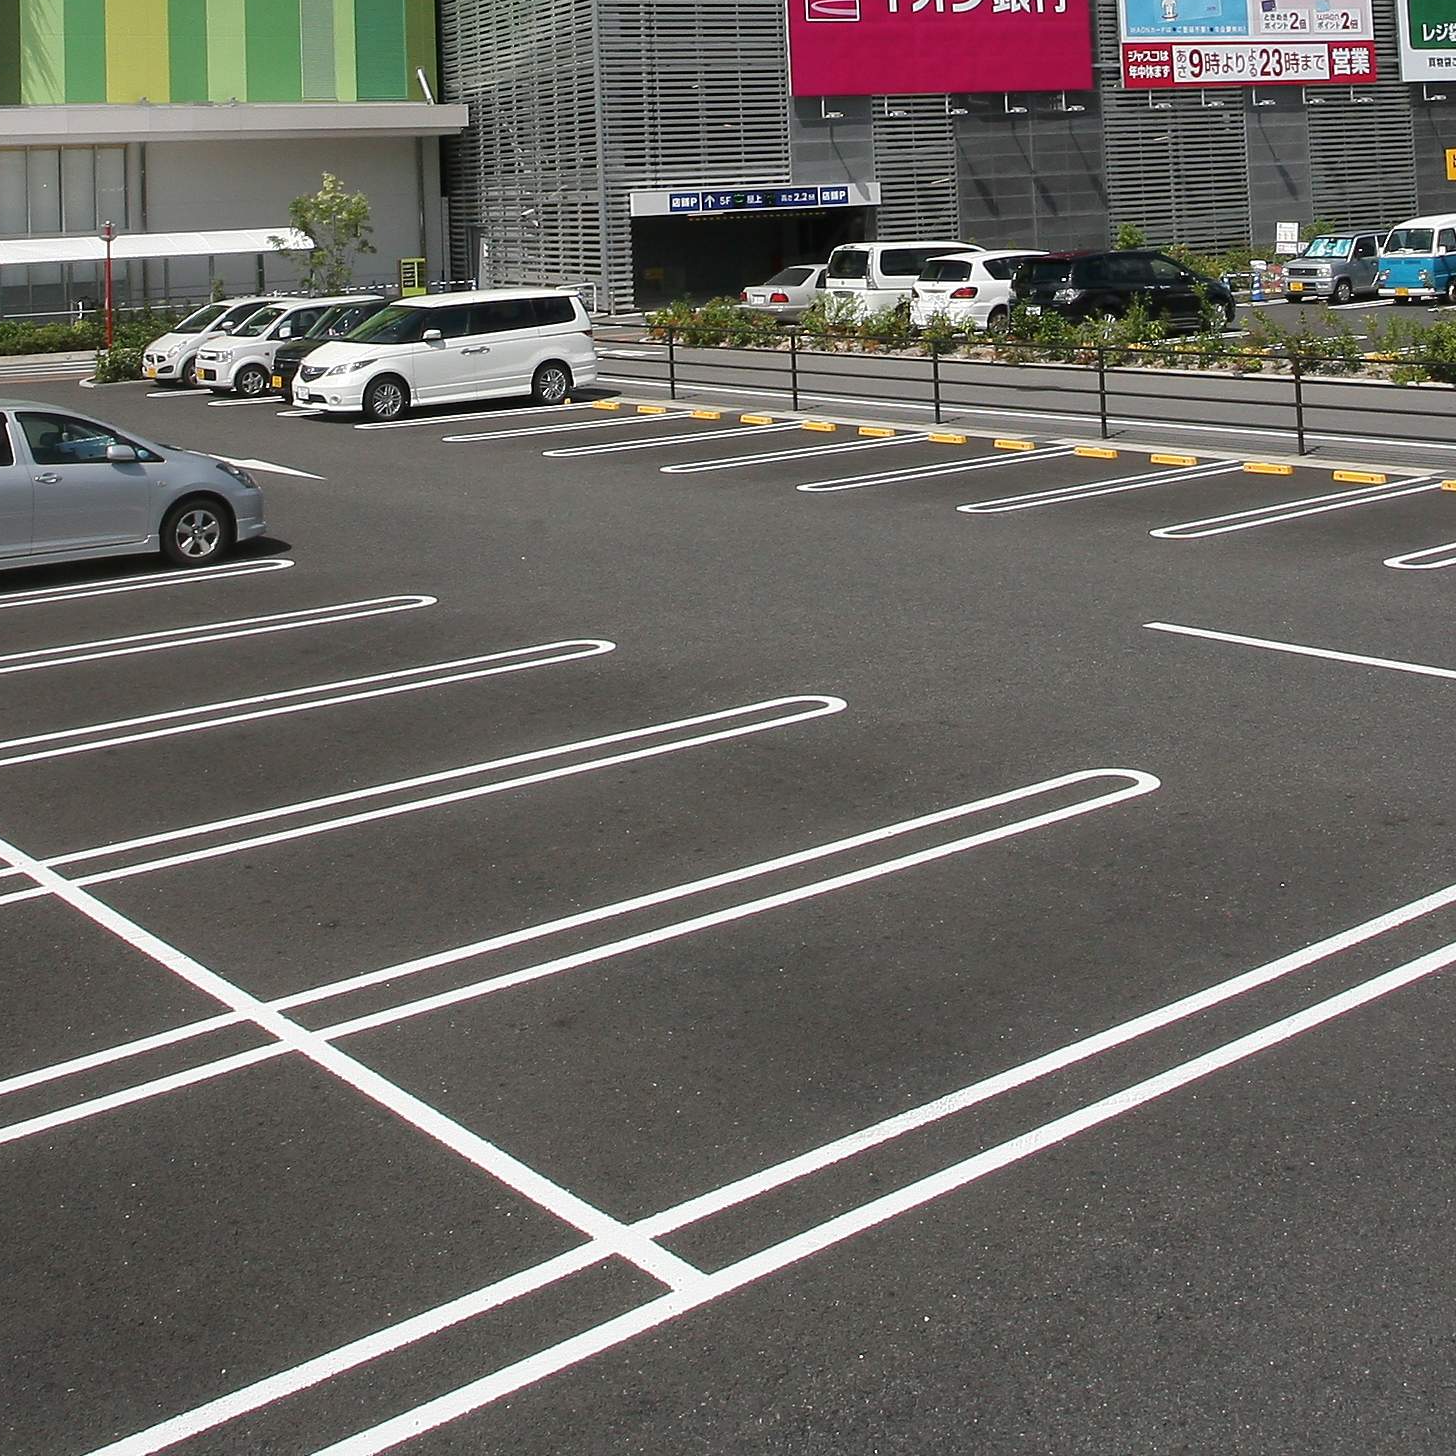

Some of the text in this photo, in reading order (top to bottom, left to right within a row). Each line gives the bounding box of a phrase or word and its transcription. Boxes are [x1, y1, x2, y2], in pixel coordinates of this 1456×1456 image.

[1127, 49, 1169, 62] ジャスコは
[1331, 47, 1371, 75] 営業
